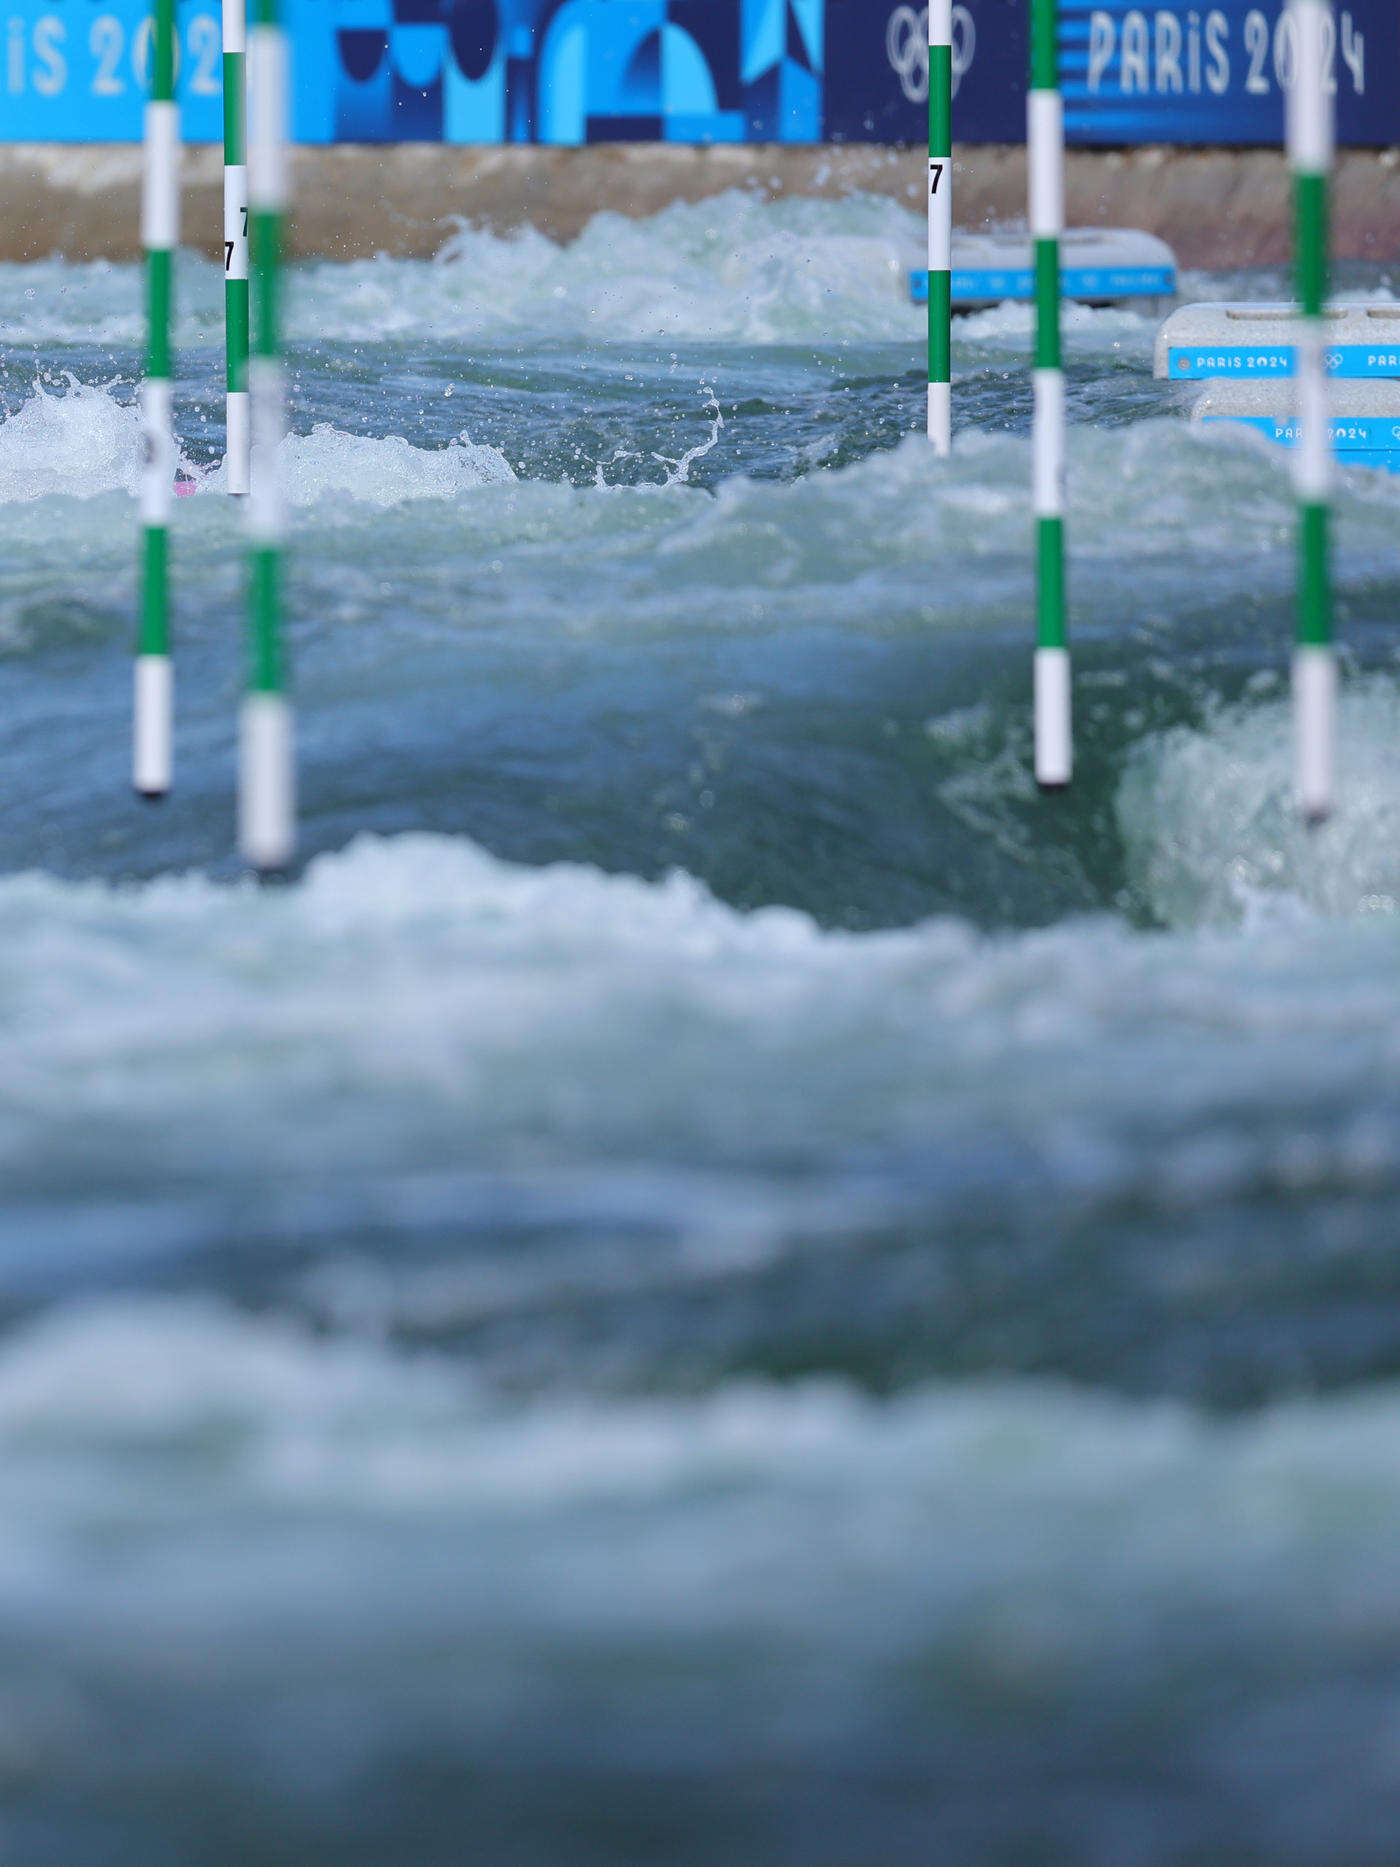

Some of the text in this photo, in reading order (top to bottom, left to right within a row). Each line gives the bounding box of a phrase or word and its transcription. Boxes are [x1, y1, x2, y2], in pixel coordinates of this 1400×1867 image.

[89, 14, 222, 95] 202
[930, 164, 943, 194] 7
[225, 241, 234, 271] 7
[1247, 356, 1288, 368] 2024
[1367, 354, 1400, 367] PAR
